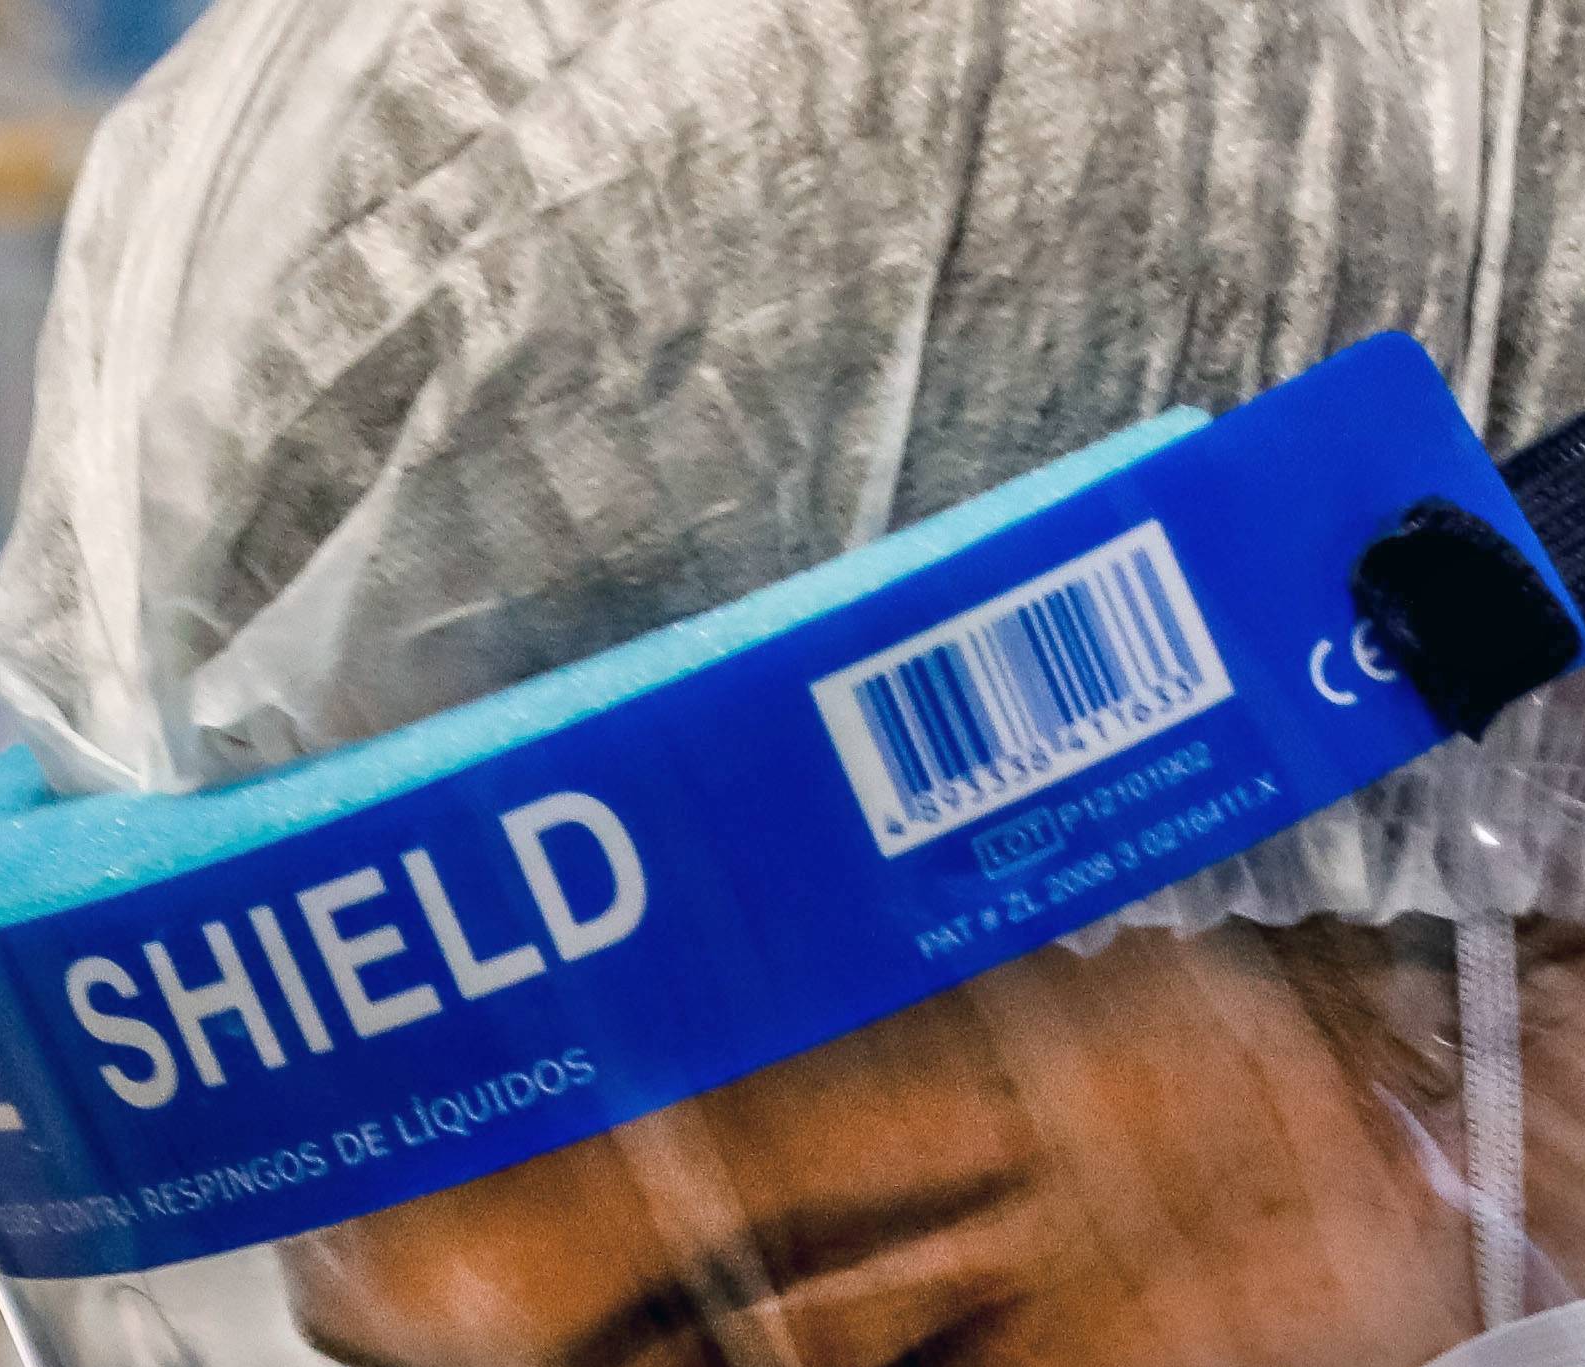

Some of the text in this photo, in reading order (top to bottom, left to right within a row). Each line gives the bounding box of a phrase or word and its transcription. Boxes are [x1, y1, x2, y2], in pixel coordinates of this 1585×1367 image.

[979, 814, 1053, 872] LOT
[64, 790, 649, 1112] SHIELD
[914, 912, 973, 961] PAT
[42, 1195, 140, 1234] CONTRA
[138, 1140, 330, 1217] RESPINGOS
[331, 1121, 393, 1167] DE
[392, 1046, 598, 1147] LÍQUIDOS
